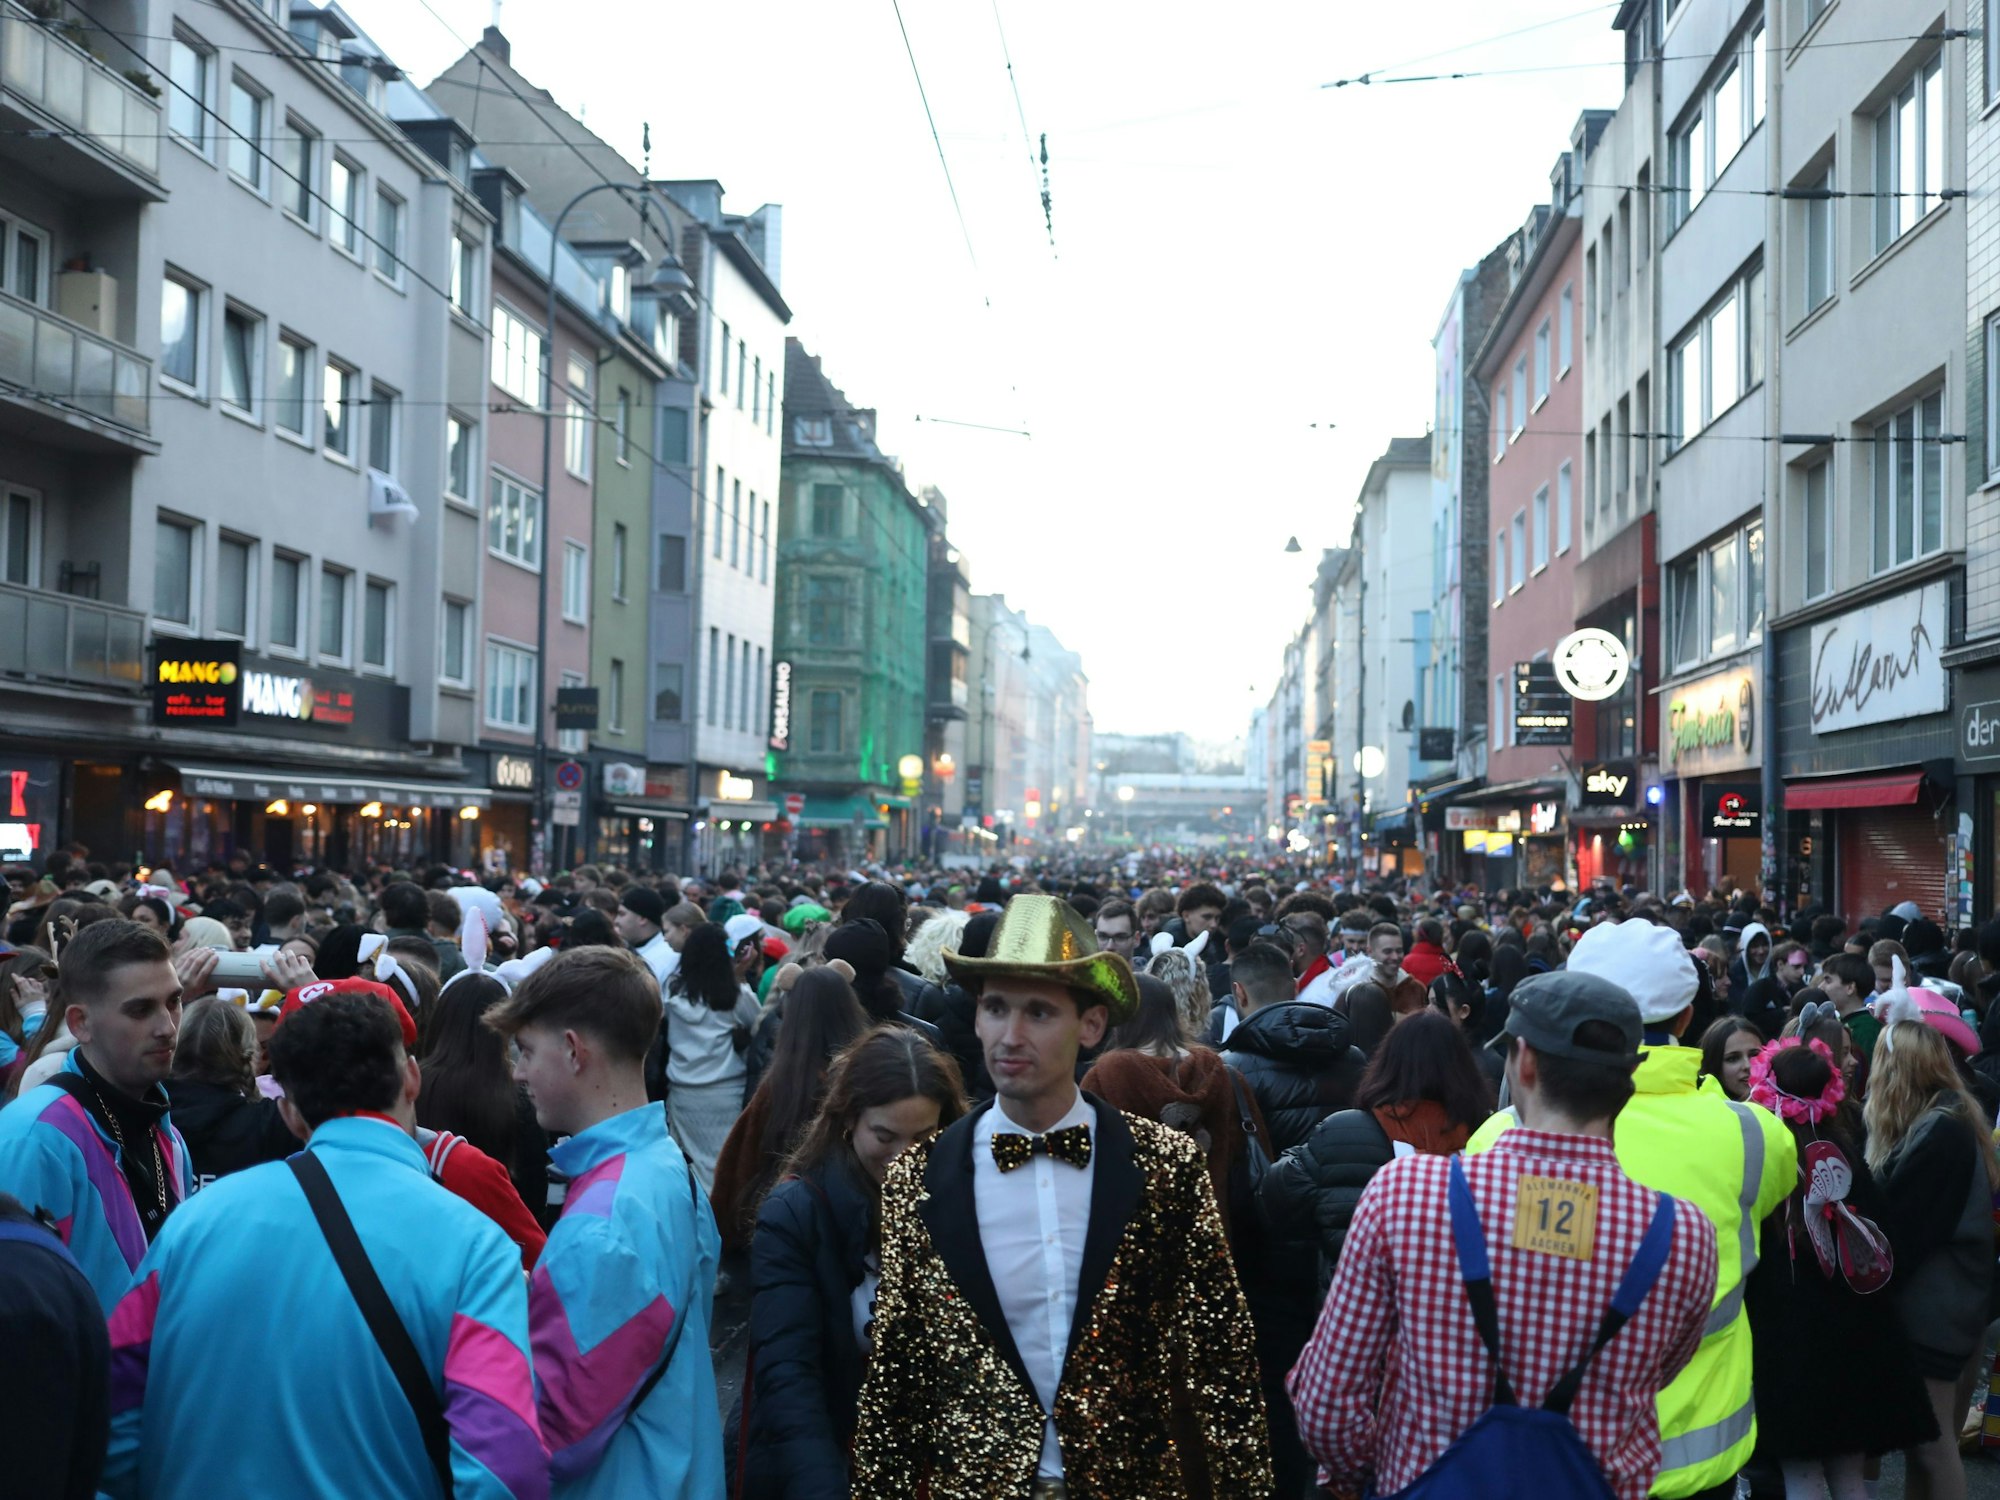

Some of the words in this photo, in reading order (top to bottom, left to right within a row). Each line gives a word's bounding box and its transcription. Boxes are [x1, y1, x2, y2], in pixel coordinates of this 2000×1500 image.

[159, 660, 237, 684] MANGO
[1587, 770, 1628, 797] sky
[1538, 1198, 1575, 1235] 12
[1530, 1236, 1576, 1254] AACHEN
